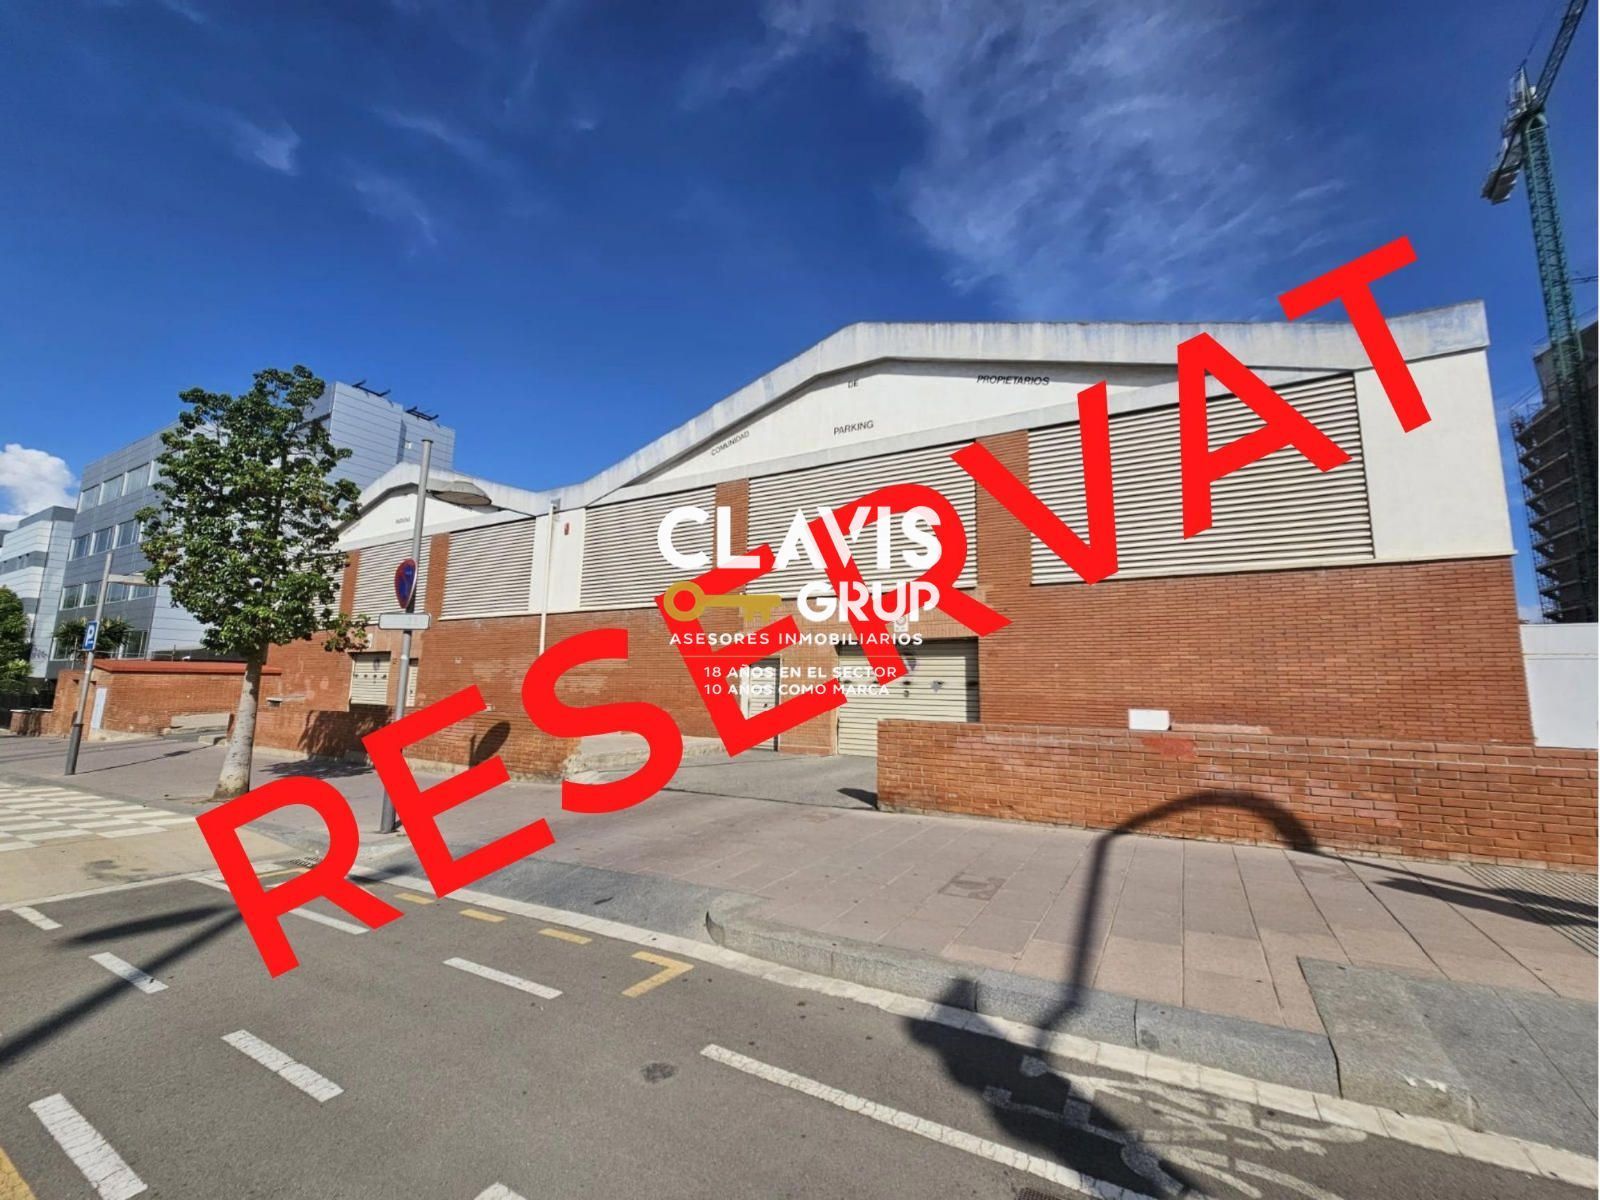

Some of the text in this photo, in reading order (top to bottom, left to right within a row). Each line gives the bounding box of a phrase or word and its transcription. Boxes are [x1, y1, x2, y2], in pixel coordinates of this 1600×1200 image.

[711, 374, 1050, 456] COMUNIDAD DE PROPIETARIOS
[833, 420, 875, 436] PARKING
